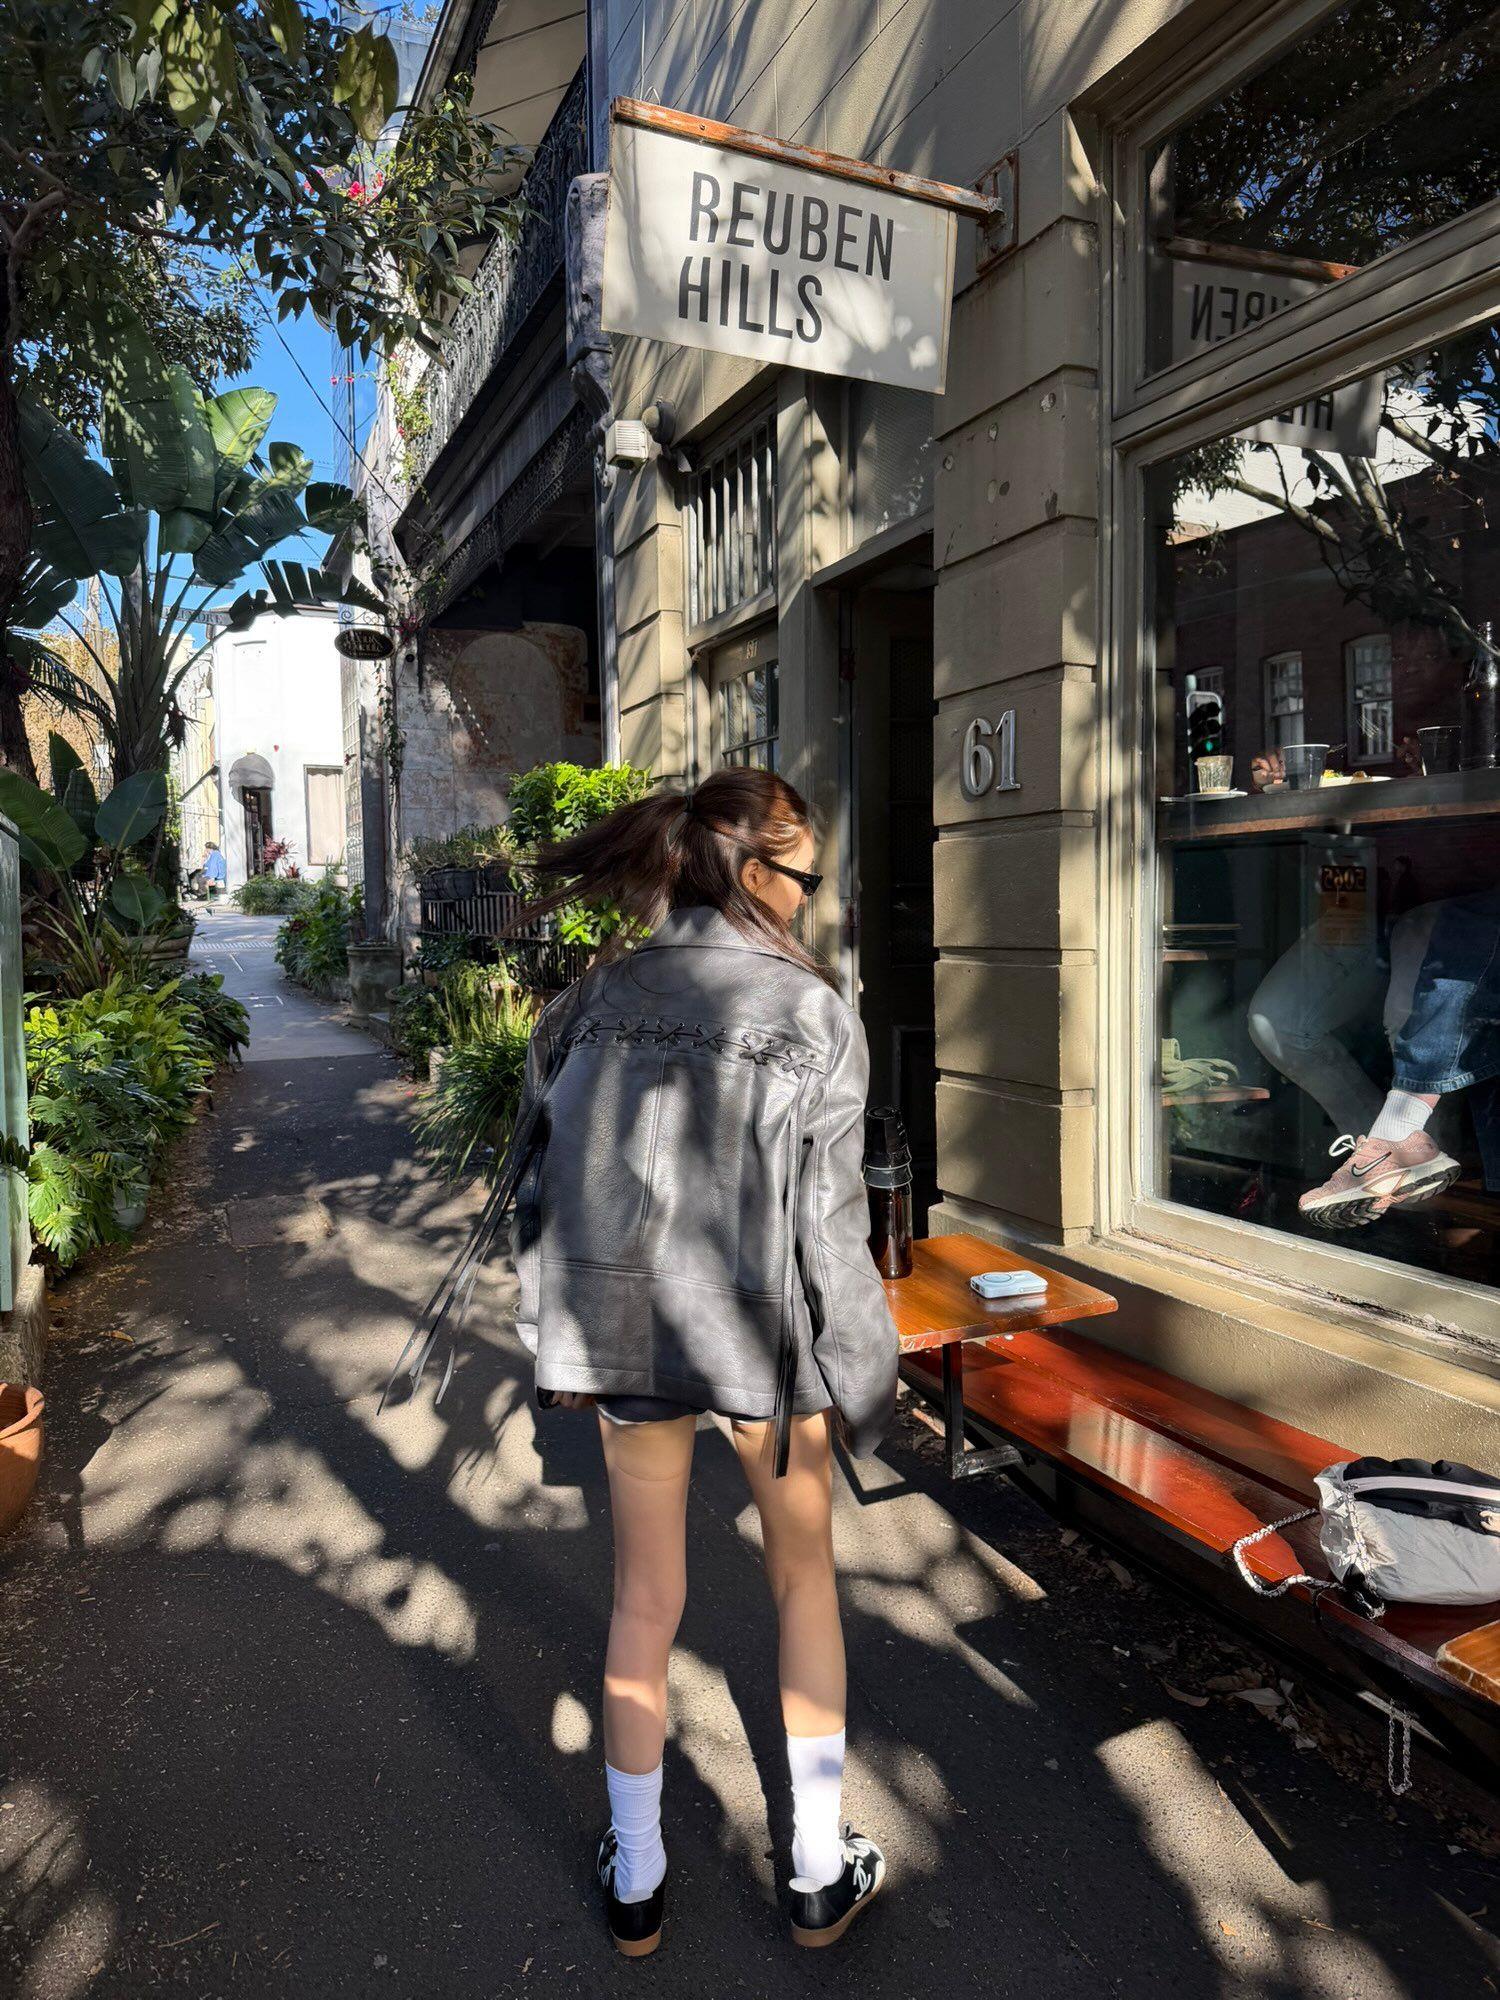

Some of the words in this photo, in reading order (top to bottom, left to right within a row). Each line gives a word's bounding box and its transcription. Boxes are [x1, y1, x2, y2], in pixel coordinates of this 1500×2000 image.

[688, 171, 894, 281] REUBEN
[678, 256, 823, 344] HILLS
[962, 709, 1021, 797] 61
